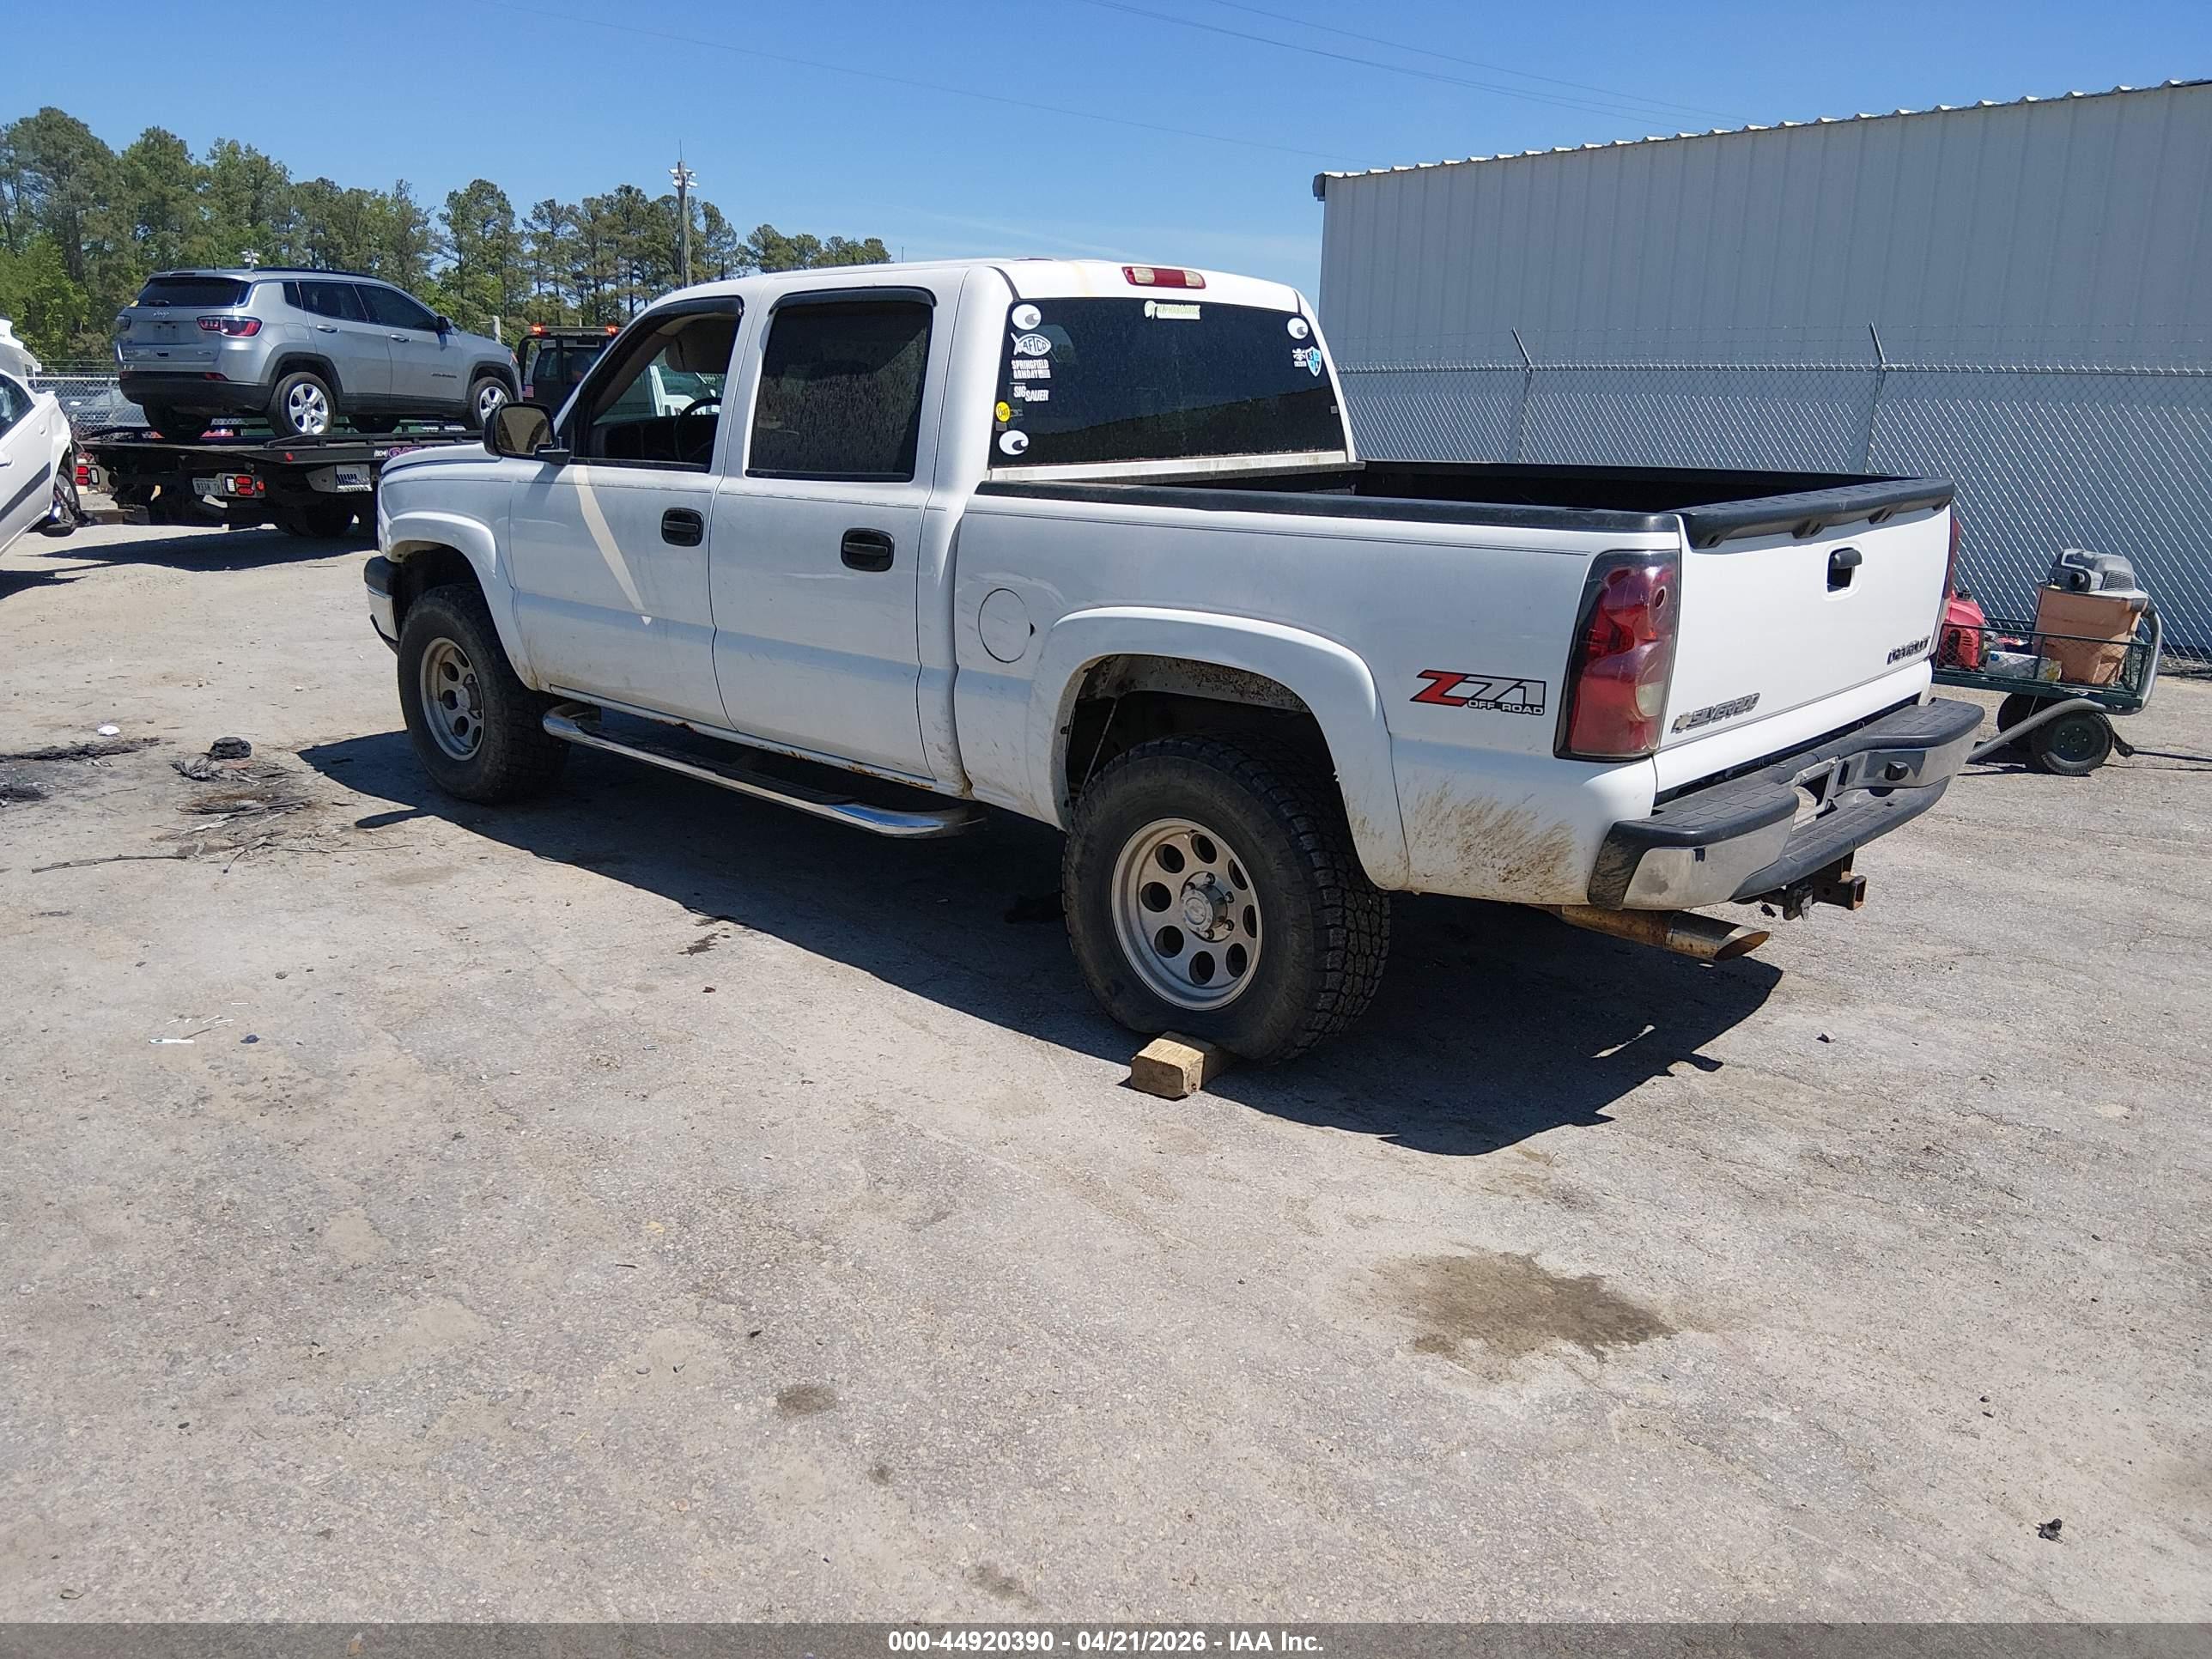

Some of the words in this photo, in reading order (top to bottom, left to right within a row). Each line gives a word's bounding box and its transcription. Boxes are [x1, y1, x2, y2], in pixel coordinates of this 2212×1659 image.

[1011, 359, 1049, 370] SPRINGFIELD
[1013, 386, 1026, 398] SIG
[1024, 389, 1049, 402] SAUER
[1410, 670, 1547, 707] Z71
[1468, 700, 1496, 709] OFF
[1502, 703, 1544, 715] ROAD
[1686, 692, 1760, 731] SILVERADO
